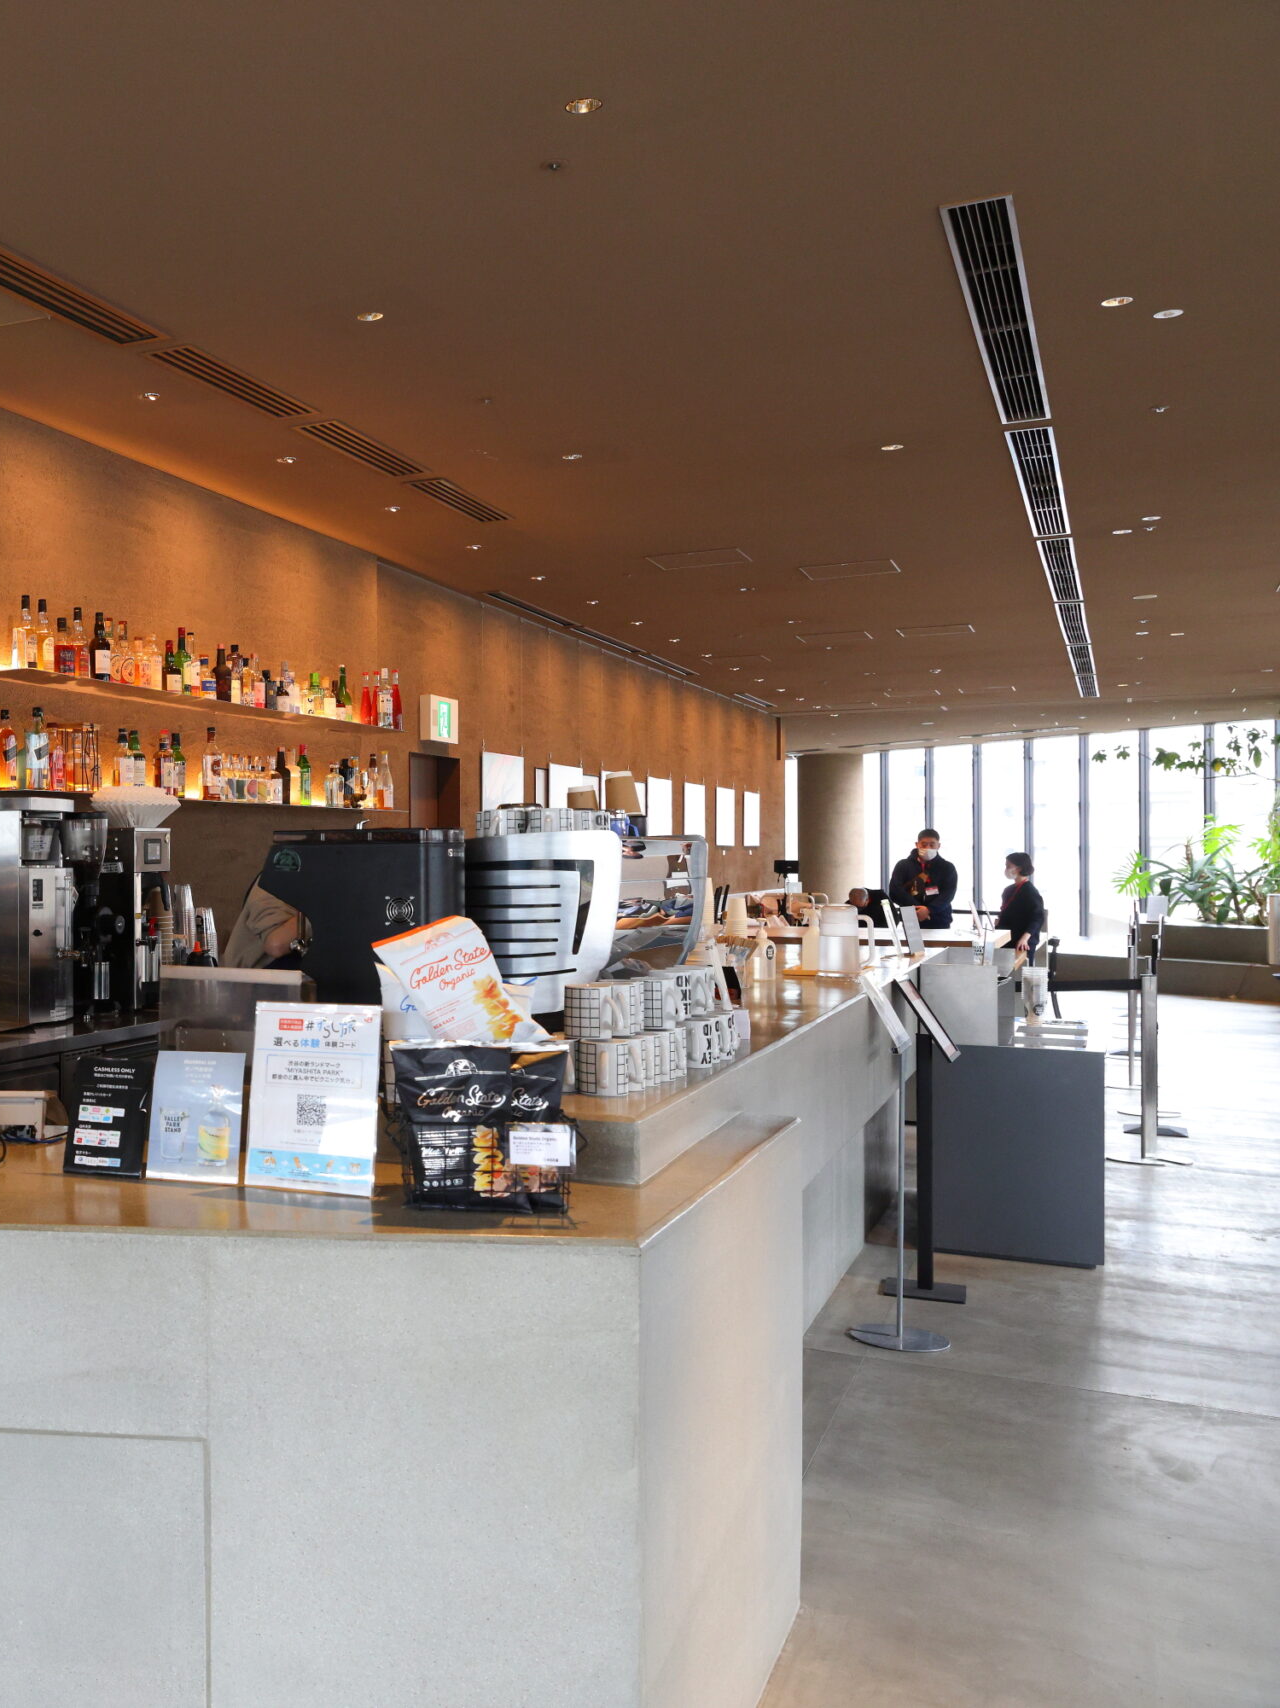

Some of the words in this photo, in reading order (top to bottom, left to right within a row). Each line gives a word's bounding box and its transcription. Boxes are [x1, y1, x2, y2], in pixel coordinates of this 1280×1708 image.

[409, 956, 453, 990] Golden
[454, 946, 493, 970] State
[438, 968, 476, 990] Organic
[274, 1037, 320, 1048] 選べる体験
[416, 1086, 466, 1108] Golden
[465, 1084, 506, 1108] State
[442, 1106, 485, 1122] Organic
